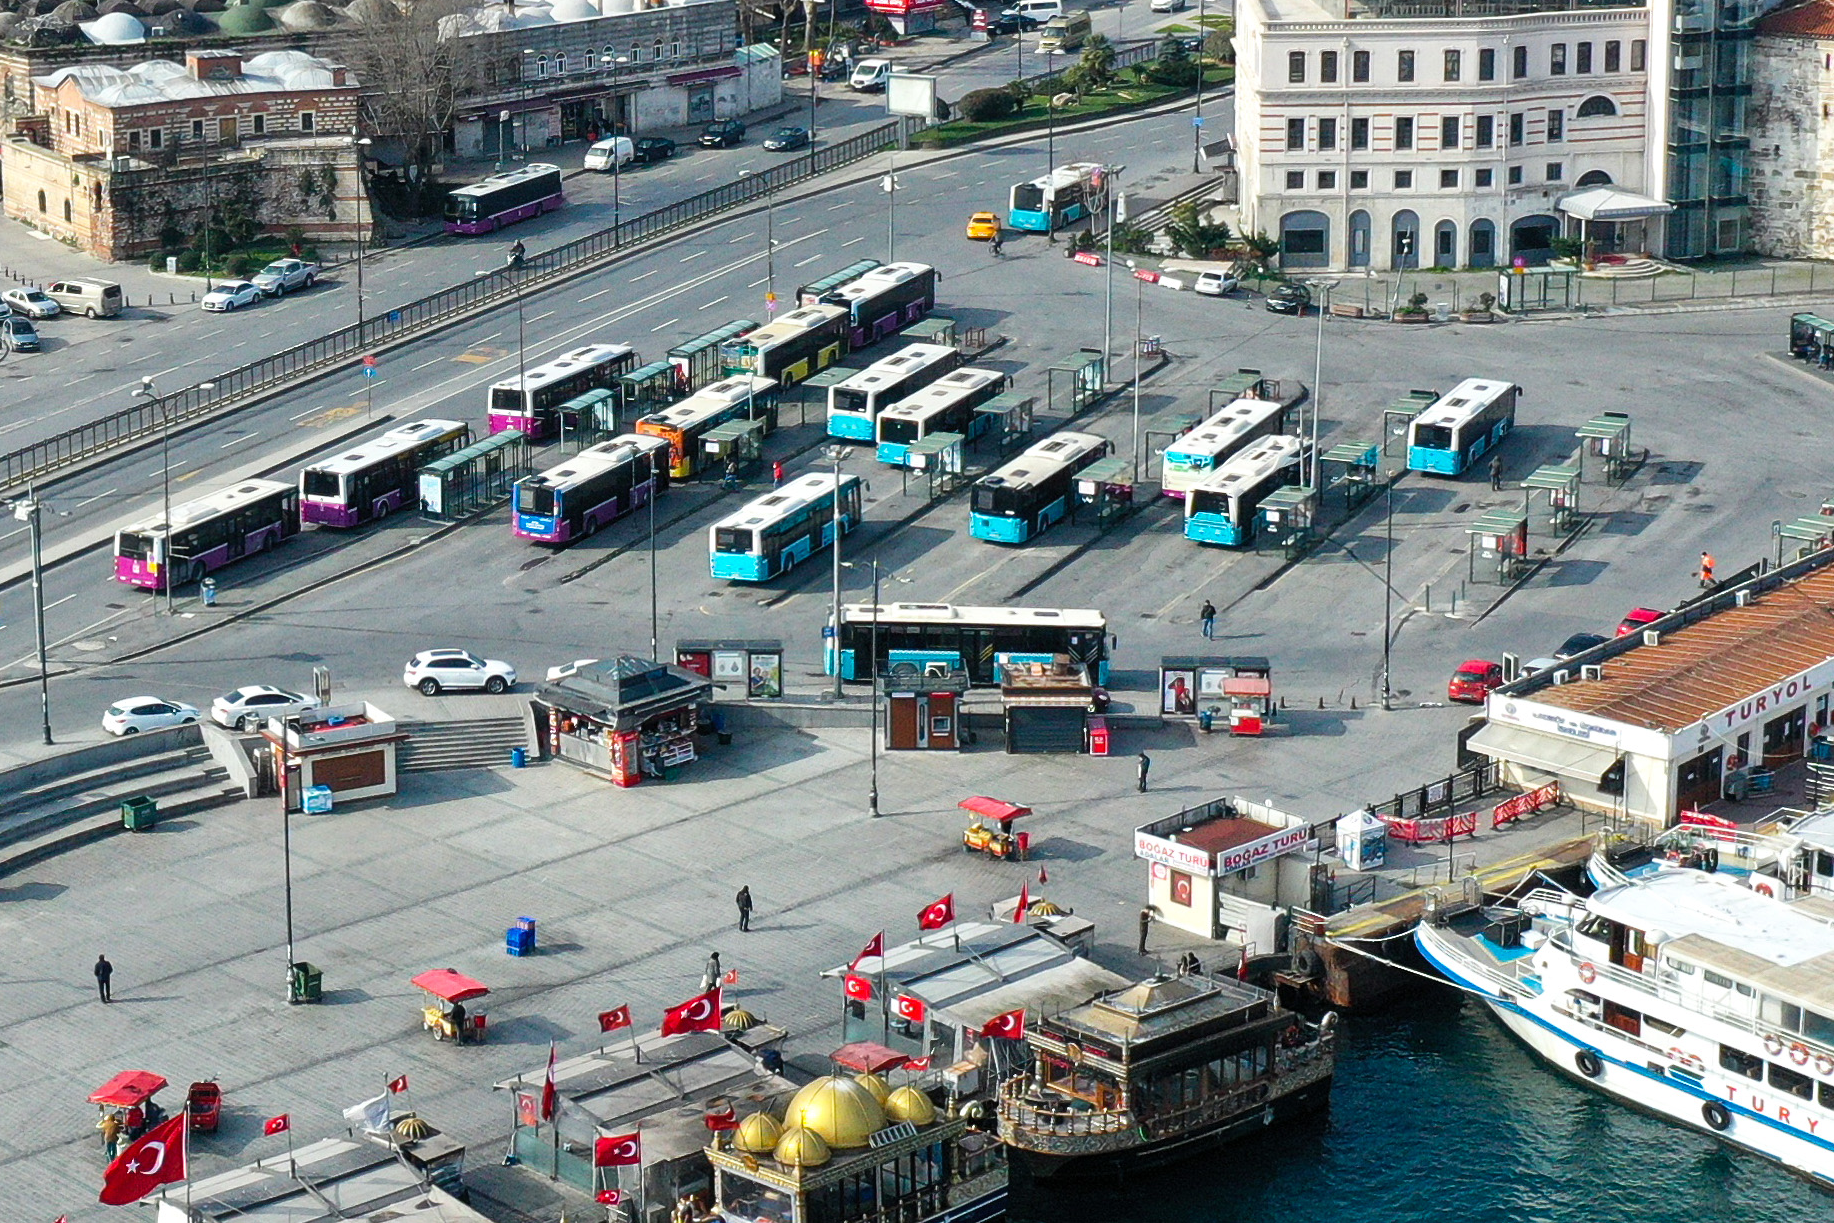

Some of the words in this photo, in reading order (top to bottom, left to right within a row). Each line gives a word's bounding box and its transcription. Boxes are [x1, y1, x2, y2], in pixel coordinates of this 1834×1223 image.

[1725, 676, 1812, 728] TURYOL
[1139, 839, 1176, 860] BOĞAZ
[1178, 851, 1210, 868] TURU
[1224, 843, 1270, 868] BOĞAZ
[1273, 829, 1308, 850] TURU
[1726, 1085, 1819, 1134] TURY
